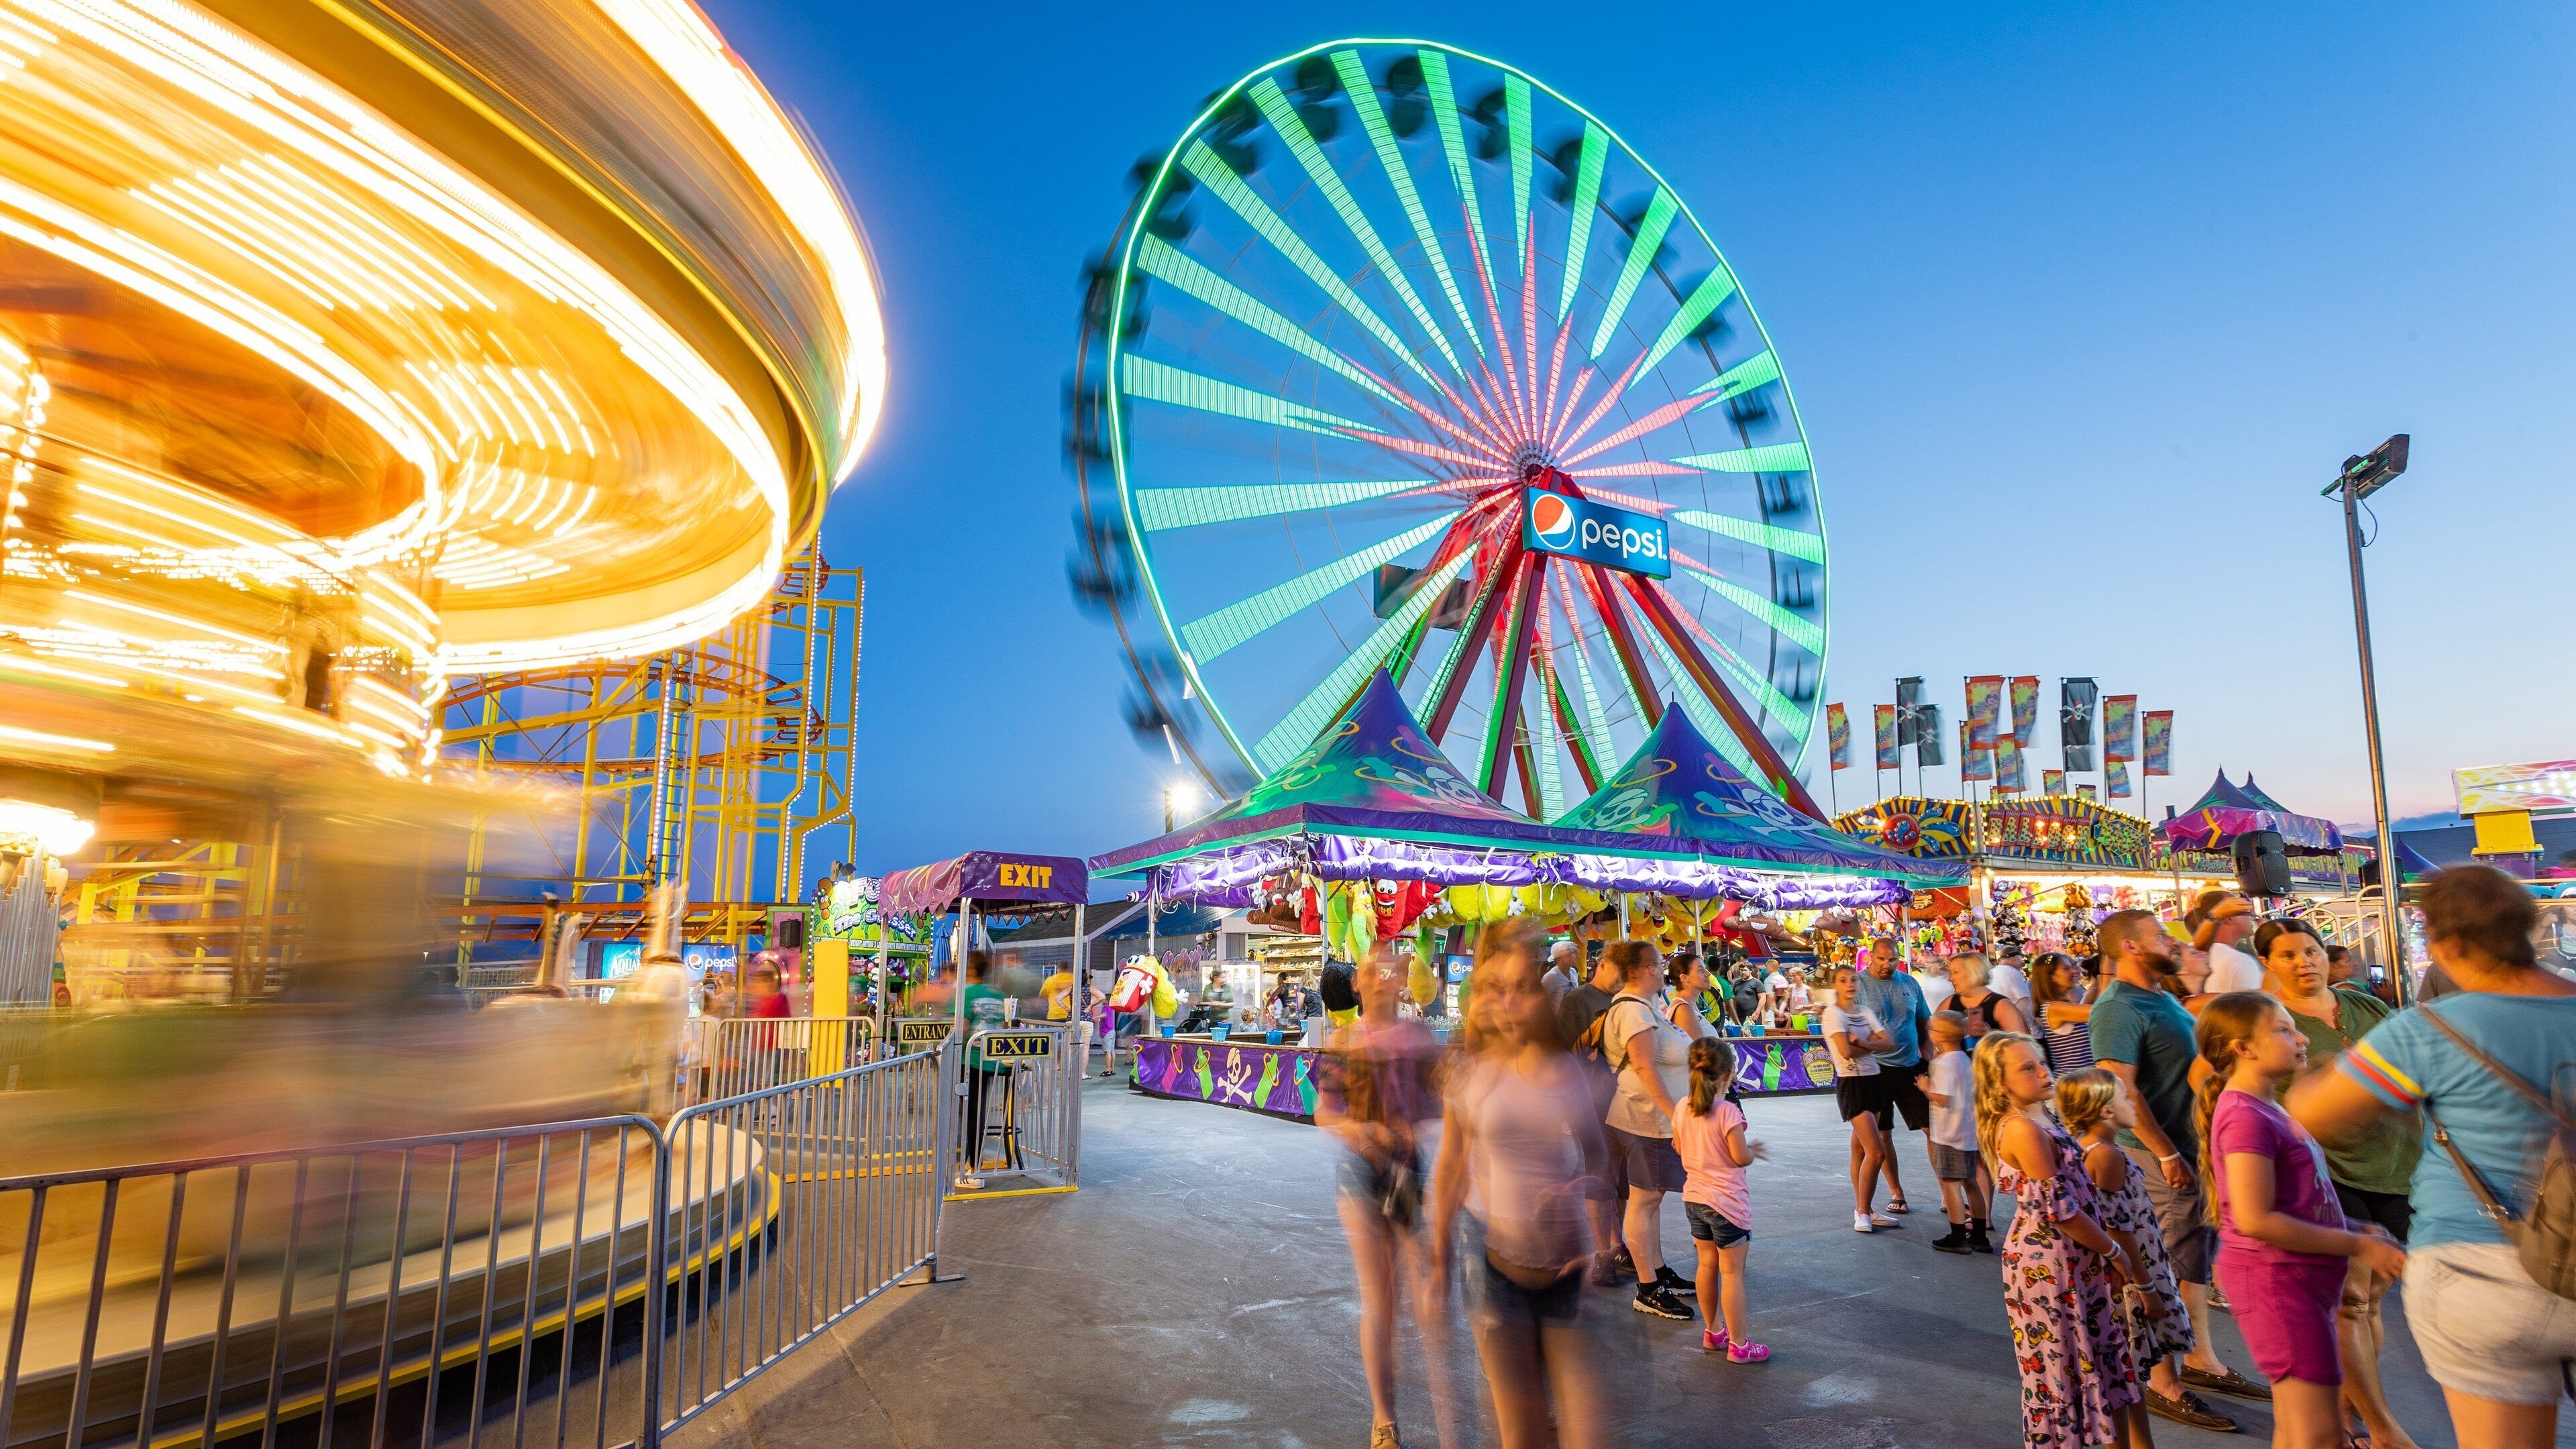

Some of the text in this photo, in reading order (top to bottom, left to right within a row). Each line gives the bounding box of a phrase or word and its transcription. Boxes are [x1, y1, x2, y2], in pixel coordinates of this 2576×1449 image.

[1582, 519, 1667, 560] pepsi
[1000, 863, 1052, 888] EXIT
[705, 957, 735, 971] pepsi
[990, 1037, 1046, 1055] EXIT
